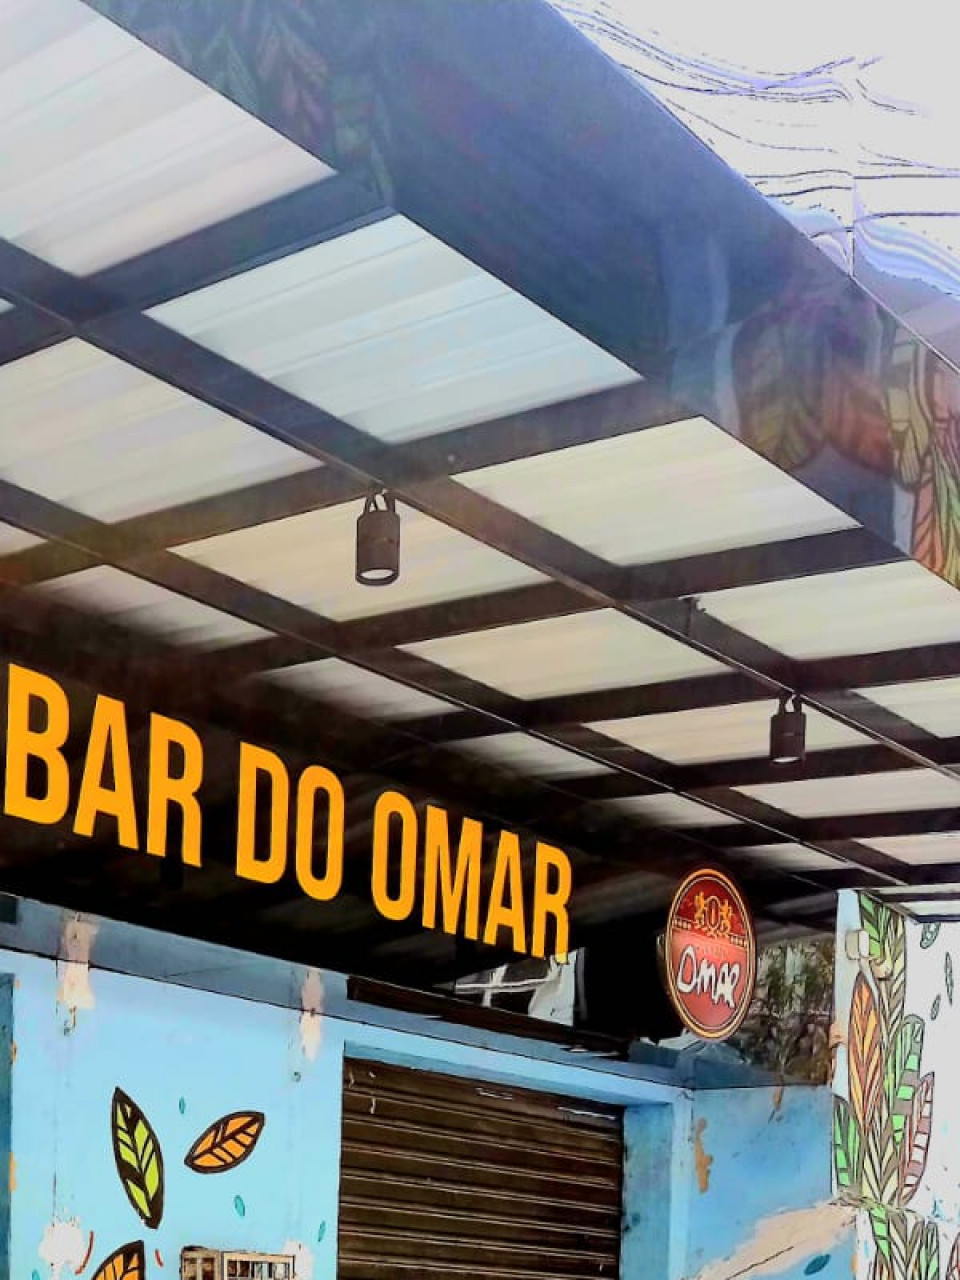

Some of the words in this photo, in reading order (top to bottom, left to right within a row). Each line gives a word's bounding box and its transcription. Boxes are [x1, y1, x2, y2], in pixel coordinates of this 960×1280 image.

[4, 663, 204, 867] BAR
[236, 741, 344, 901] DO
[371, 791, 572, 964] OMAR
